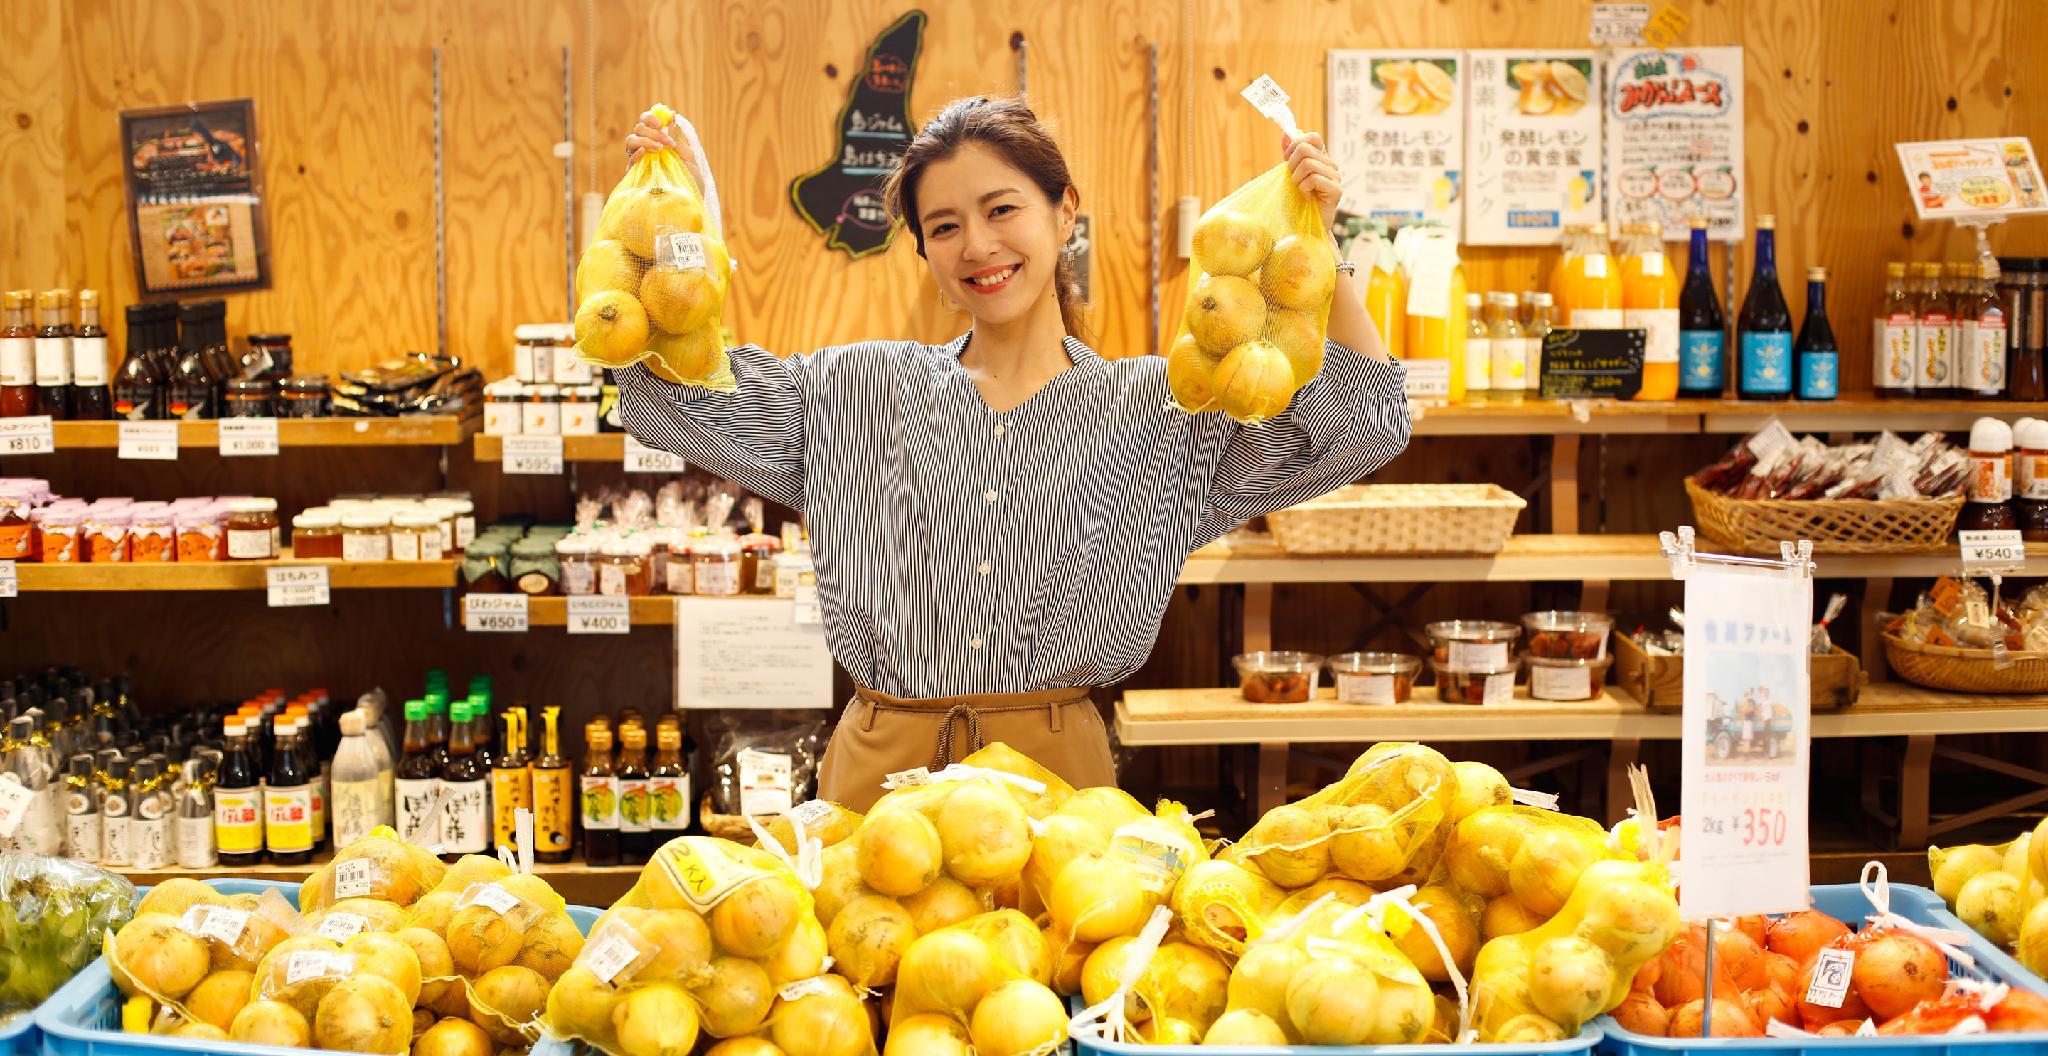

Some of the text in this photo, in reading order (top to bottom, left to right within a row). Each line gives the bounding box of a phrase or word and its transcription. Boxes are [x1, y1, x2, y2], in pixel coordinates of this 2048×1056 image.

[1363, 129, 1453, 147] 発酵レモン
[1500, 129, 1589, 147] 発酵レモン
[1976, 547, 2012, 559] ¥540
[581, 616, 618, 629] ¥400
